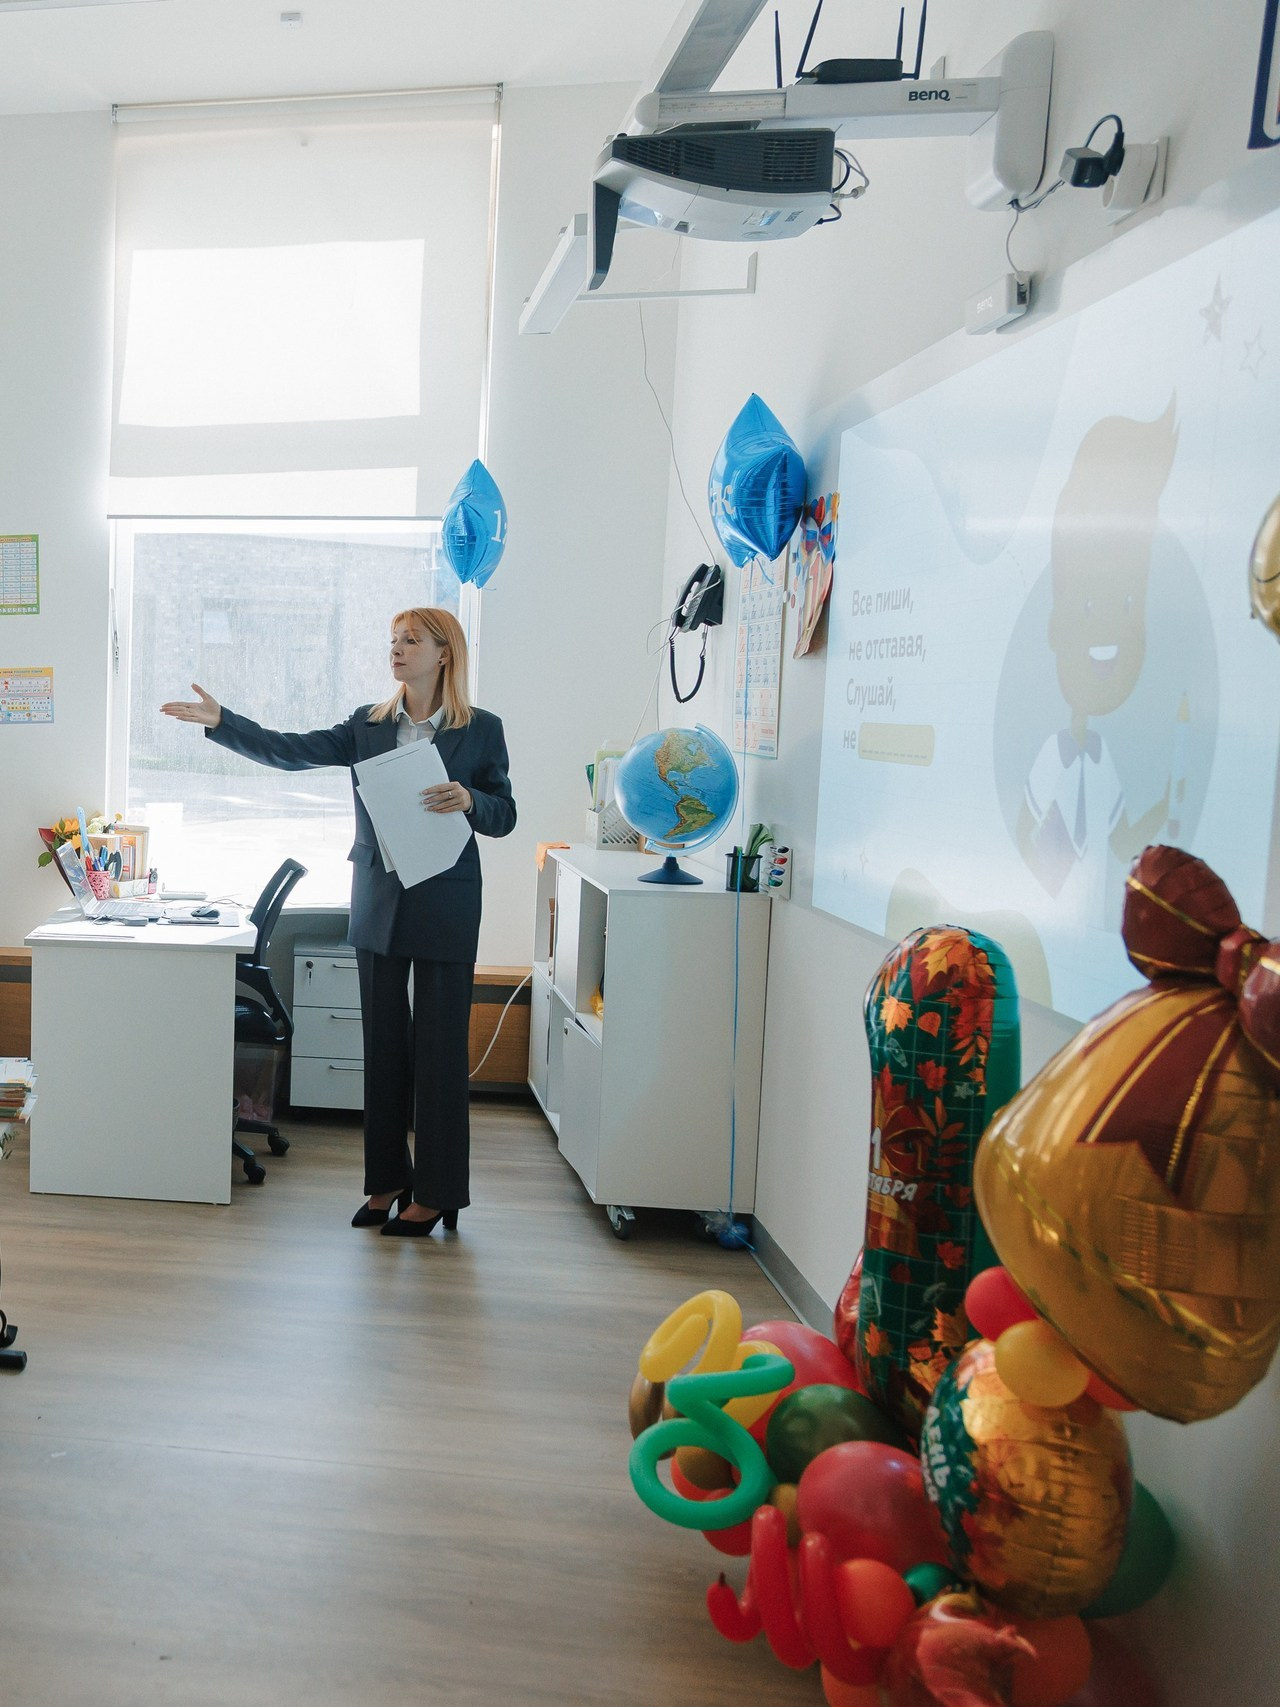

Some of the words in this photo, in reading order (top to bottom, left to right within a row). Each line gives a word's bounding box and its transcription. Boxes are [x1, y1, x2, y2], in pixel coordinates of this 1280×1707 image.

[908, 89, 951, 102] BenQ
[851, 590, 873, 617] Все
[875, 587, 914, 614] пиши,
[848, 641, 862, 661] не
[866, 634, 926, 662] отставая,
[846, 676, 896, 713] Слушай,
[843, 729, 857, 750] не
[868, 1172, 918, 1201] ТЯБРЯ
[923, 1405, 951, 1488] ДЕНЬ
